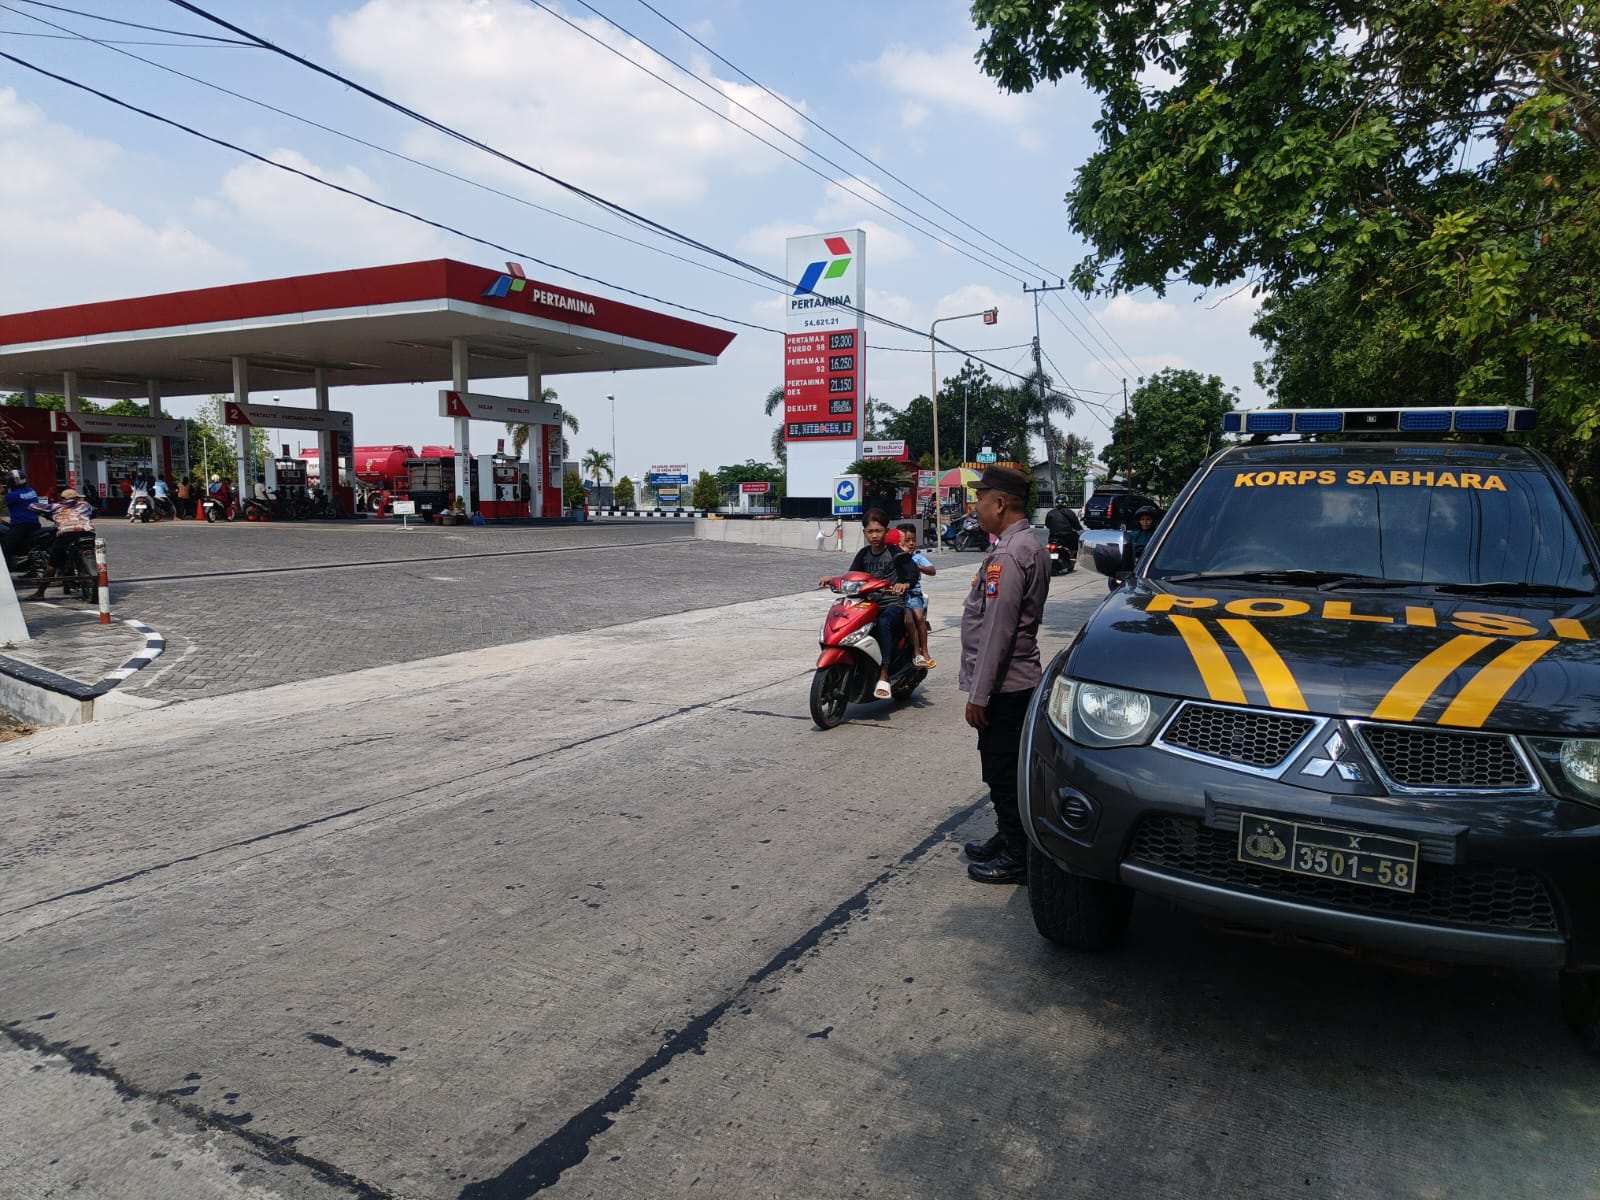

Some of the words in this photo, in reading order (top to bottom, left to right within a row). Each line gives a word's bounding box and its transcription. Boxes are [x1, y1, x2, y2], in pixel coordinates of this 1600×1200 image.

[533, 288, 596, 316] PERTAMINA
[791, 294, 852, 310] PERTAMINA
[804, 317, 839, 327] 54.621.21
[787, 335, 825, 345] PERTAMAX
[831, 335, 852, 348] 19.300
[787, 345, 812, 353] TURBO
[787, 357, 825, 366] PERTAMAX
[830, 357, 852, 370] 16.250
[787, 378, 825, 387] PERTAMINA
[830, 379, 852, 392] 21.150
[451, 399, 457, 410] 1
[787, 404, 817, 412] DEXLITE
[230, 409, 238, 418] 2
[60, 418, 68, 426] 3
[1234, 469, 1337, 489] KORPS
[1345, 469, 1508, 492] SABHARA
[1145, 593, 1591, 641] POLISI
[1348, 836, 1362, 850] X
[1299, 846, 1409, 887] 3501-58
